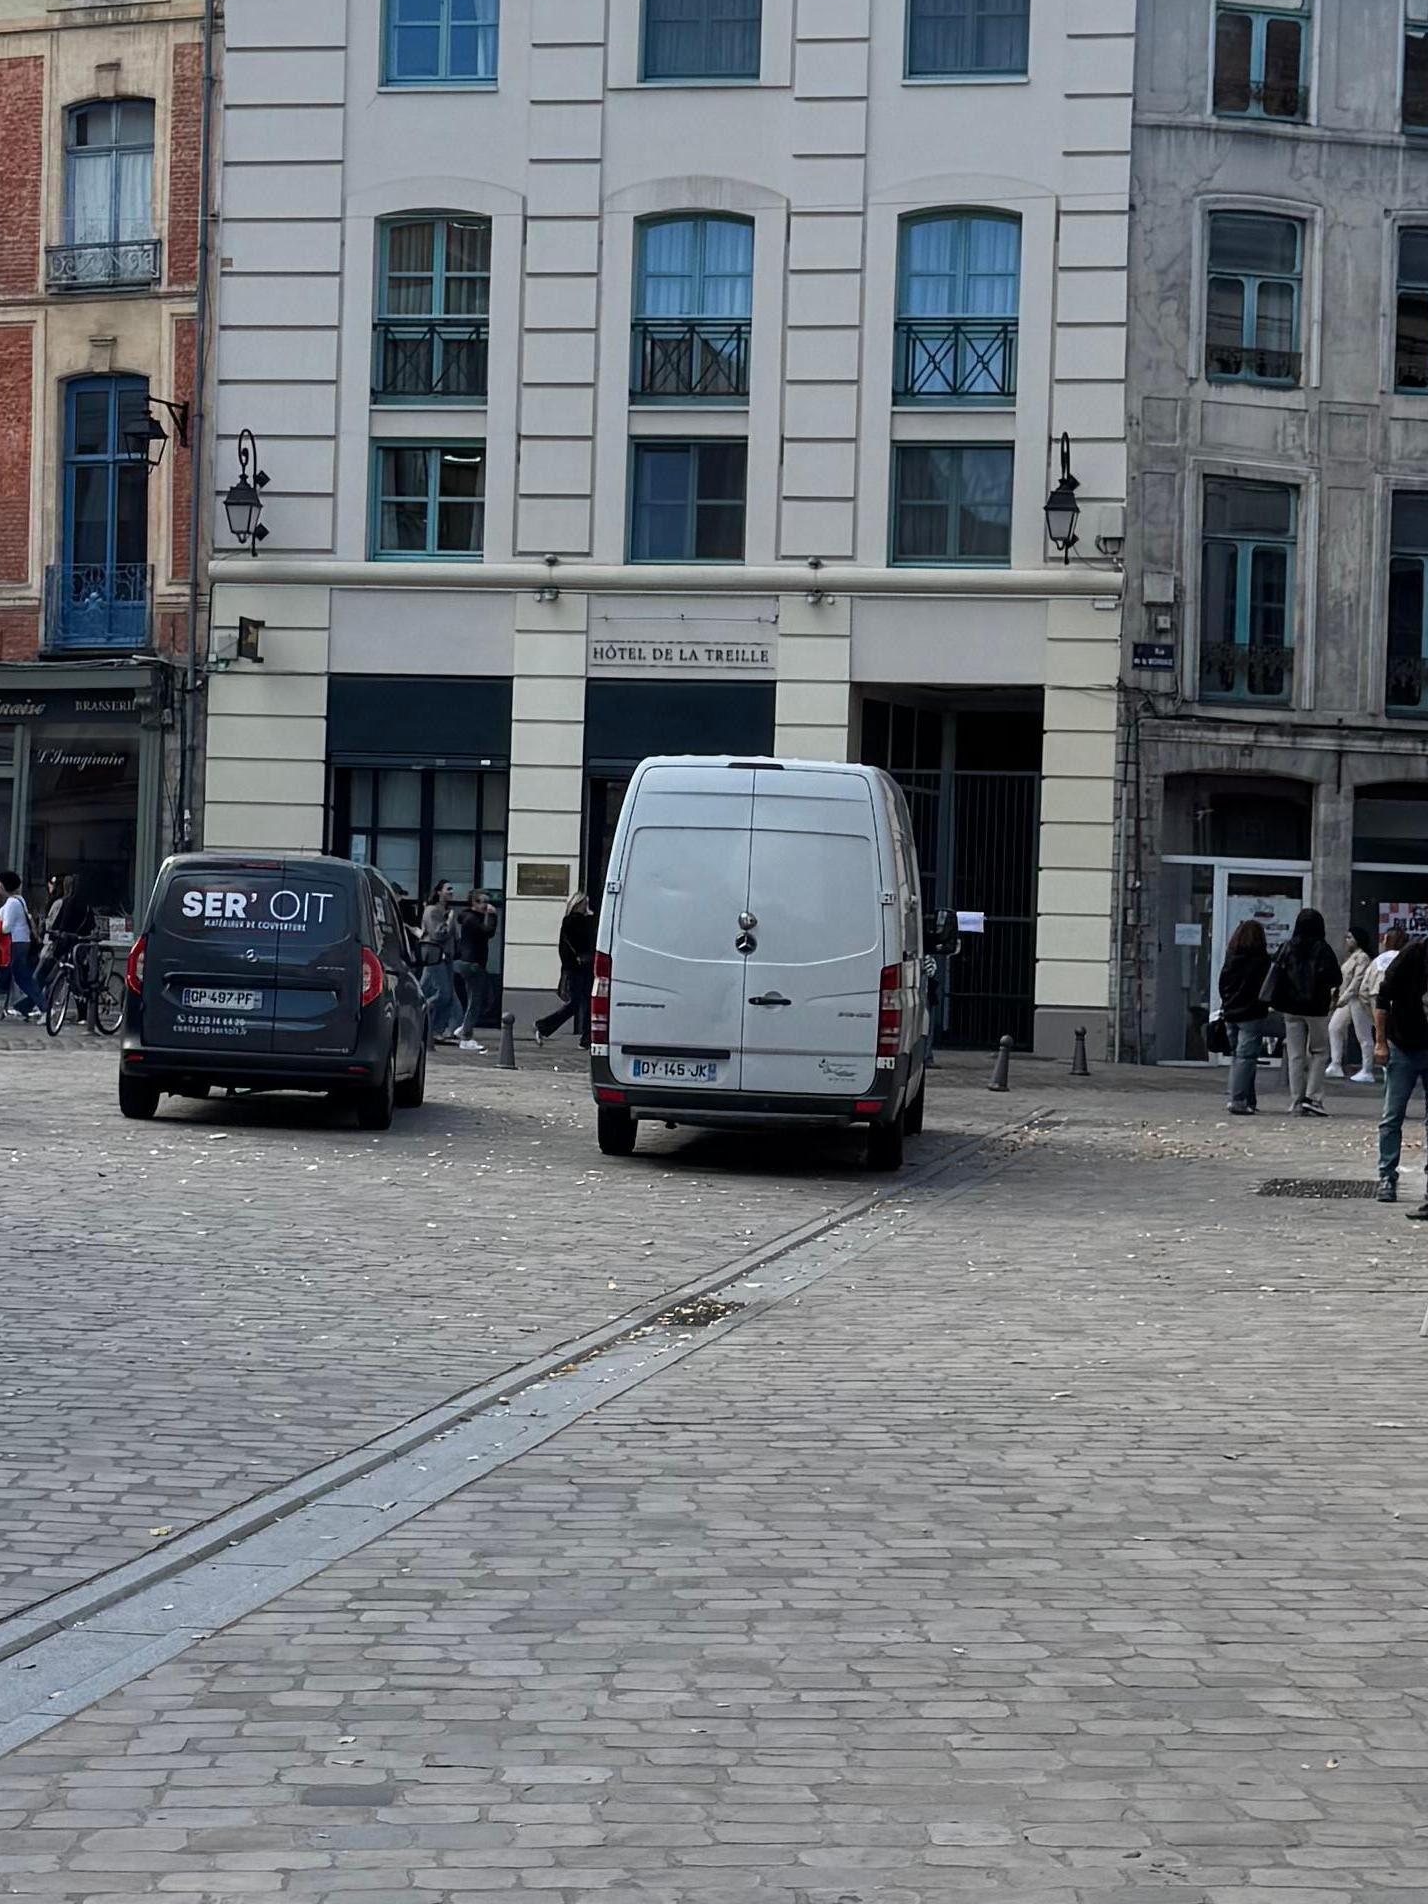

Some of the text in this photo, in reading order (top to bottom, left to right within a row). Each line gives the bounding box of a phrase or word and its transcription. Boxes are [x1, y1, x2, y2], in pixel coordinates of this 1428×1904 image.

[593, 644, 770, 663] HÔTEL DE LA TREILLE
